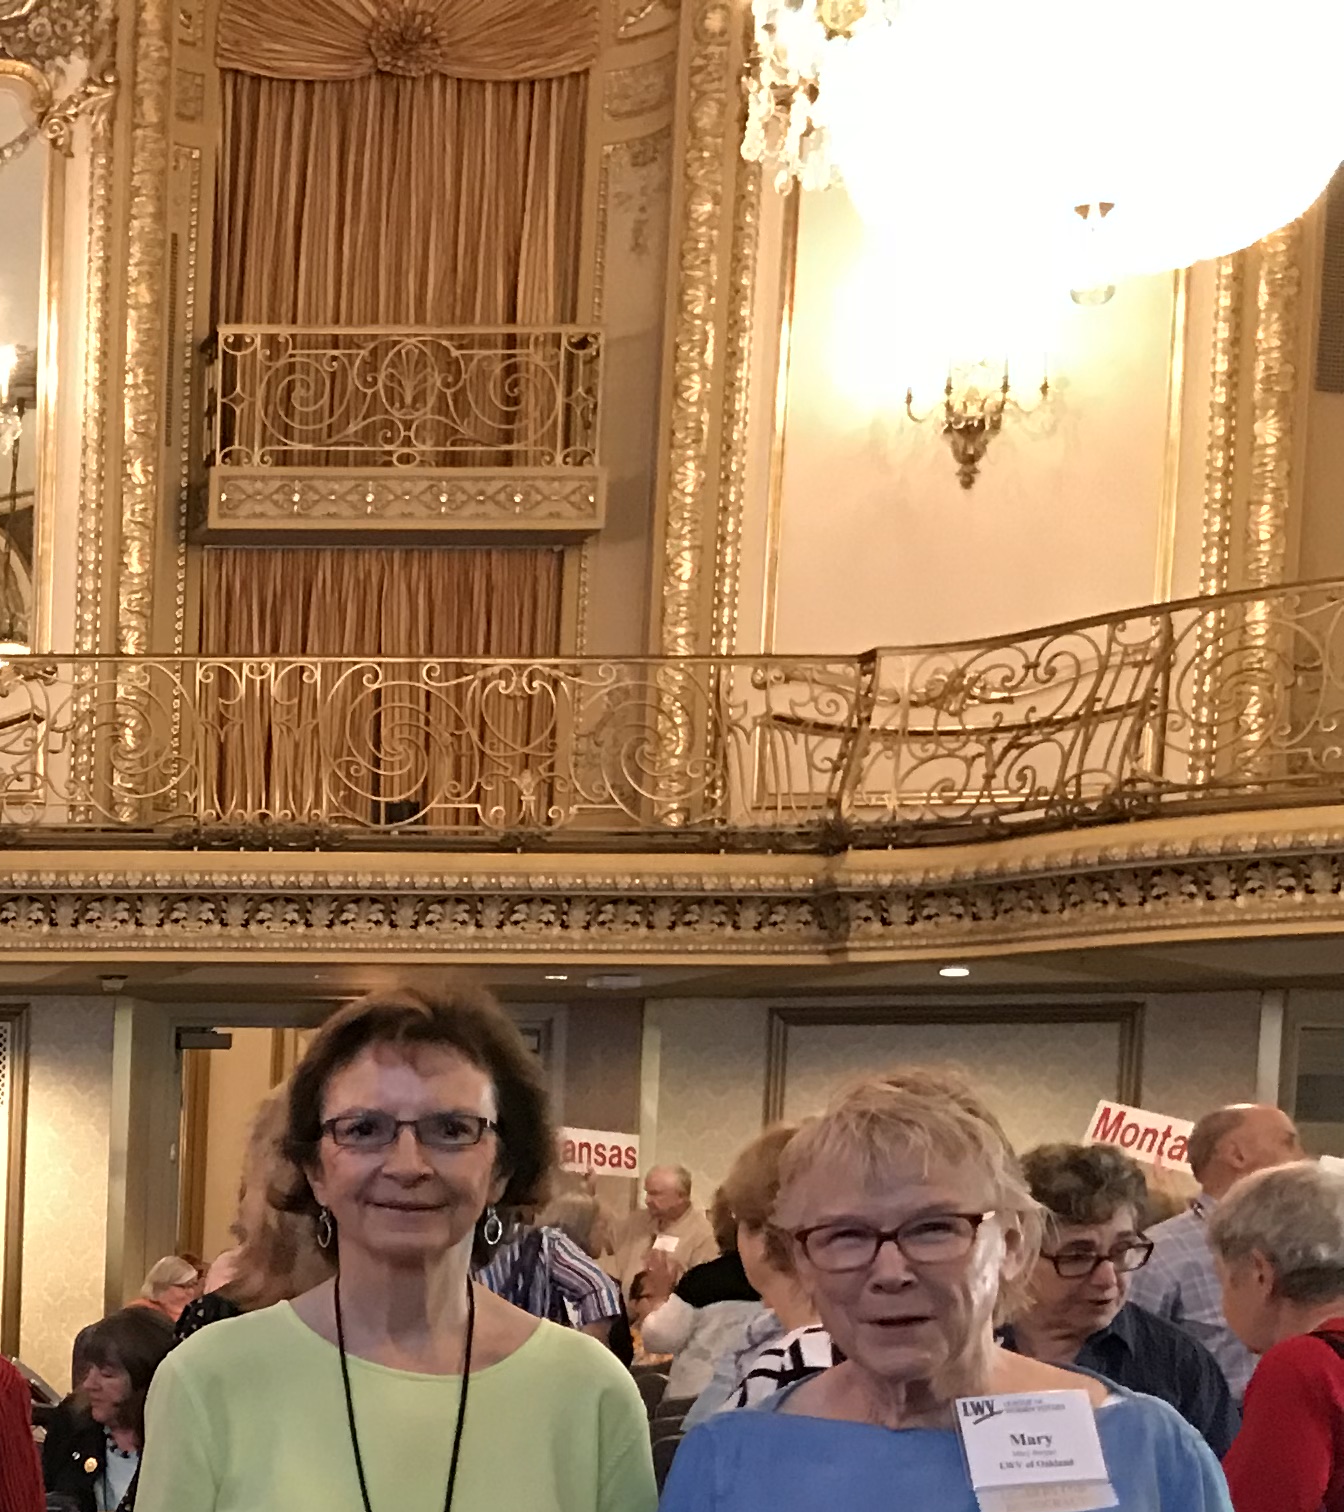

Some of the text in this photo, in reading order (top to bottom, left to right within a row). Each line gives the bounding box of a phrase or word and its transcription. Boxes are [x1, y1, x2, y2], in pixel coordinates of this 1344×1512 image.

[1092, 1106, 1188, 1161] Monta
[562, 1139, 637, 1169] ansas
[962, 1400, 995, 1416] LWV
[1010, 1434, 1053, 1447] Mary
